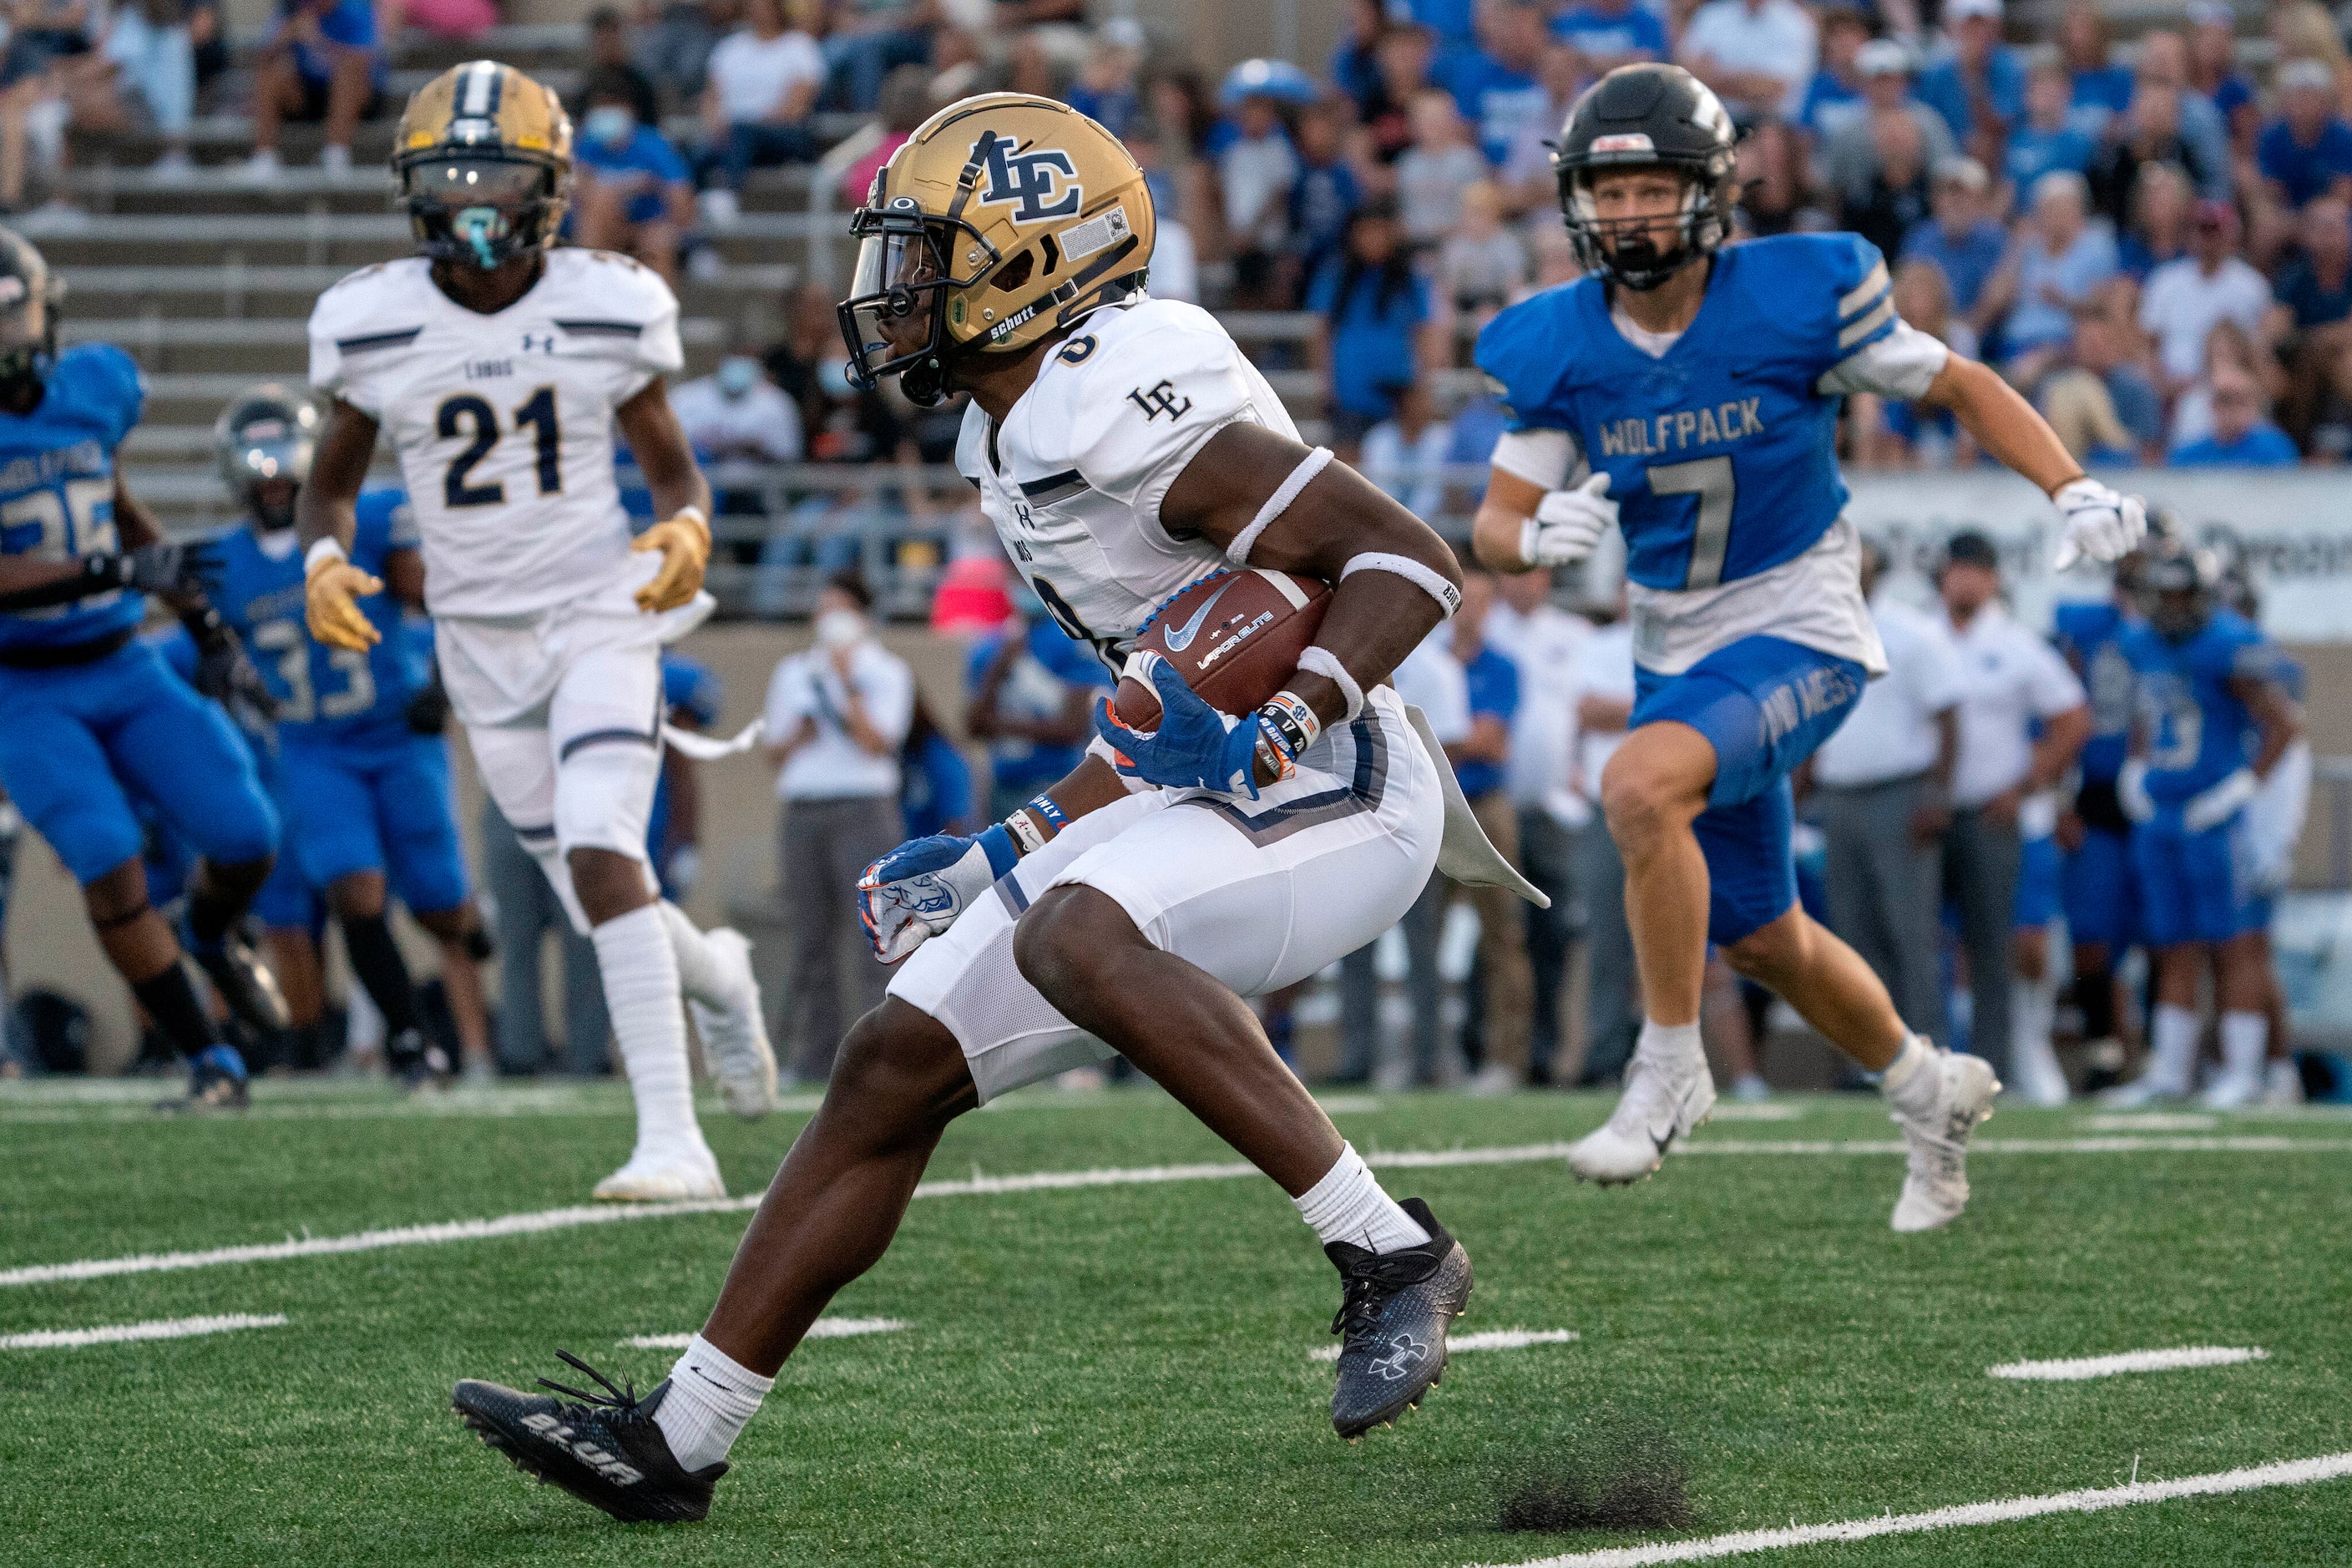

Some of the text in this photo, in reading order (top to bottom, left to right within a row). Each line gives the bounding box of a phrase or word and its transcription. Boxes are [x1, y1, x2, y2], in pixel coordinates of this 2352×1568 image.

[969, 135, 1084, 225] LE
[990, 305, 1036, 340] schutt
[1126, 378, 1193, 422] LE
[436, 385, 564, 508] 21
[1600, 396, 1764, 457] WOLFPACK
[1646, 455, 1735, 591] 7
[1196, 610, 1274, 670] VAPOR ELITE
[1258, 716, 1272, 728] GO
[1266, 726, 1292, 752] GATORS
[1263, 706, 1279, 716] 15
[1281, 719, 1297, 732] 17
[1292, 705, 1308, 721] SEC
[1033, 796, 1062, 818] ONLY
